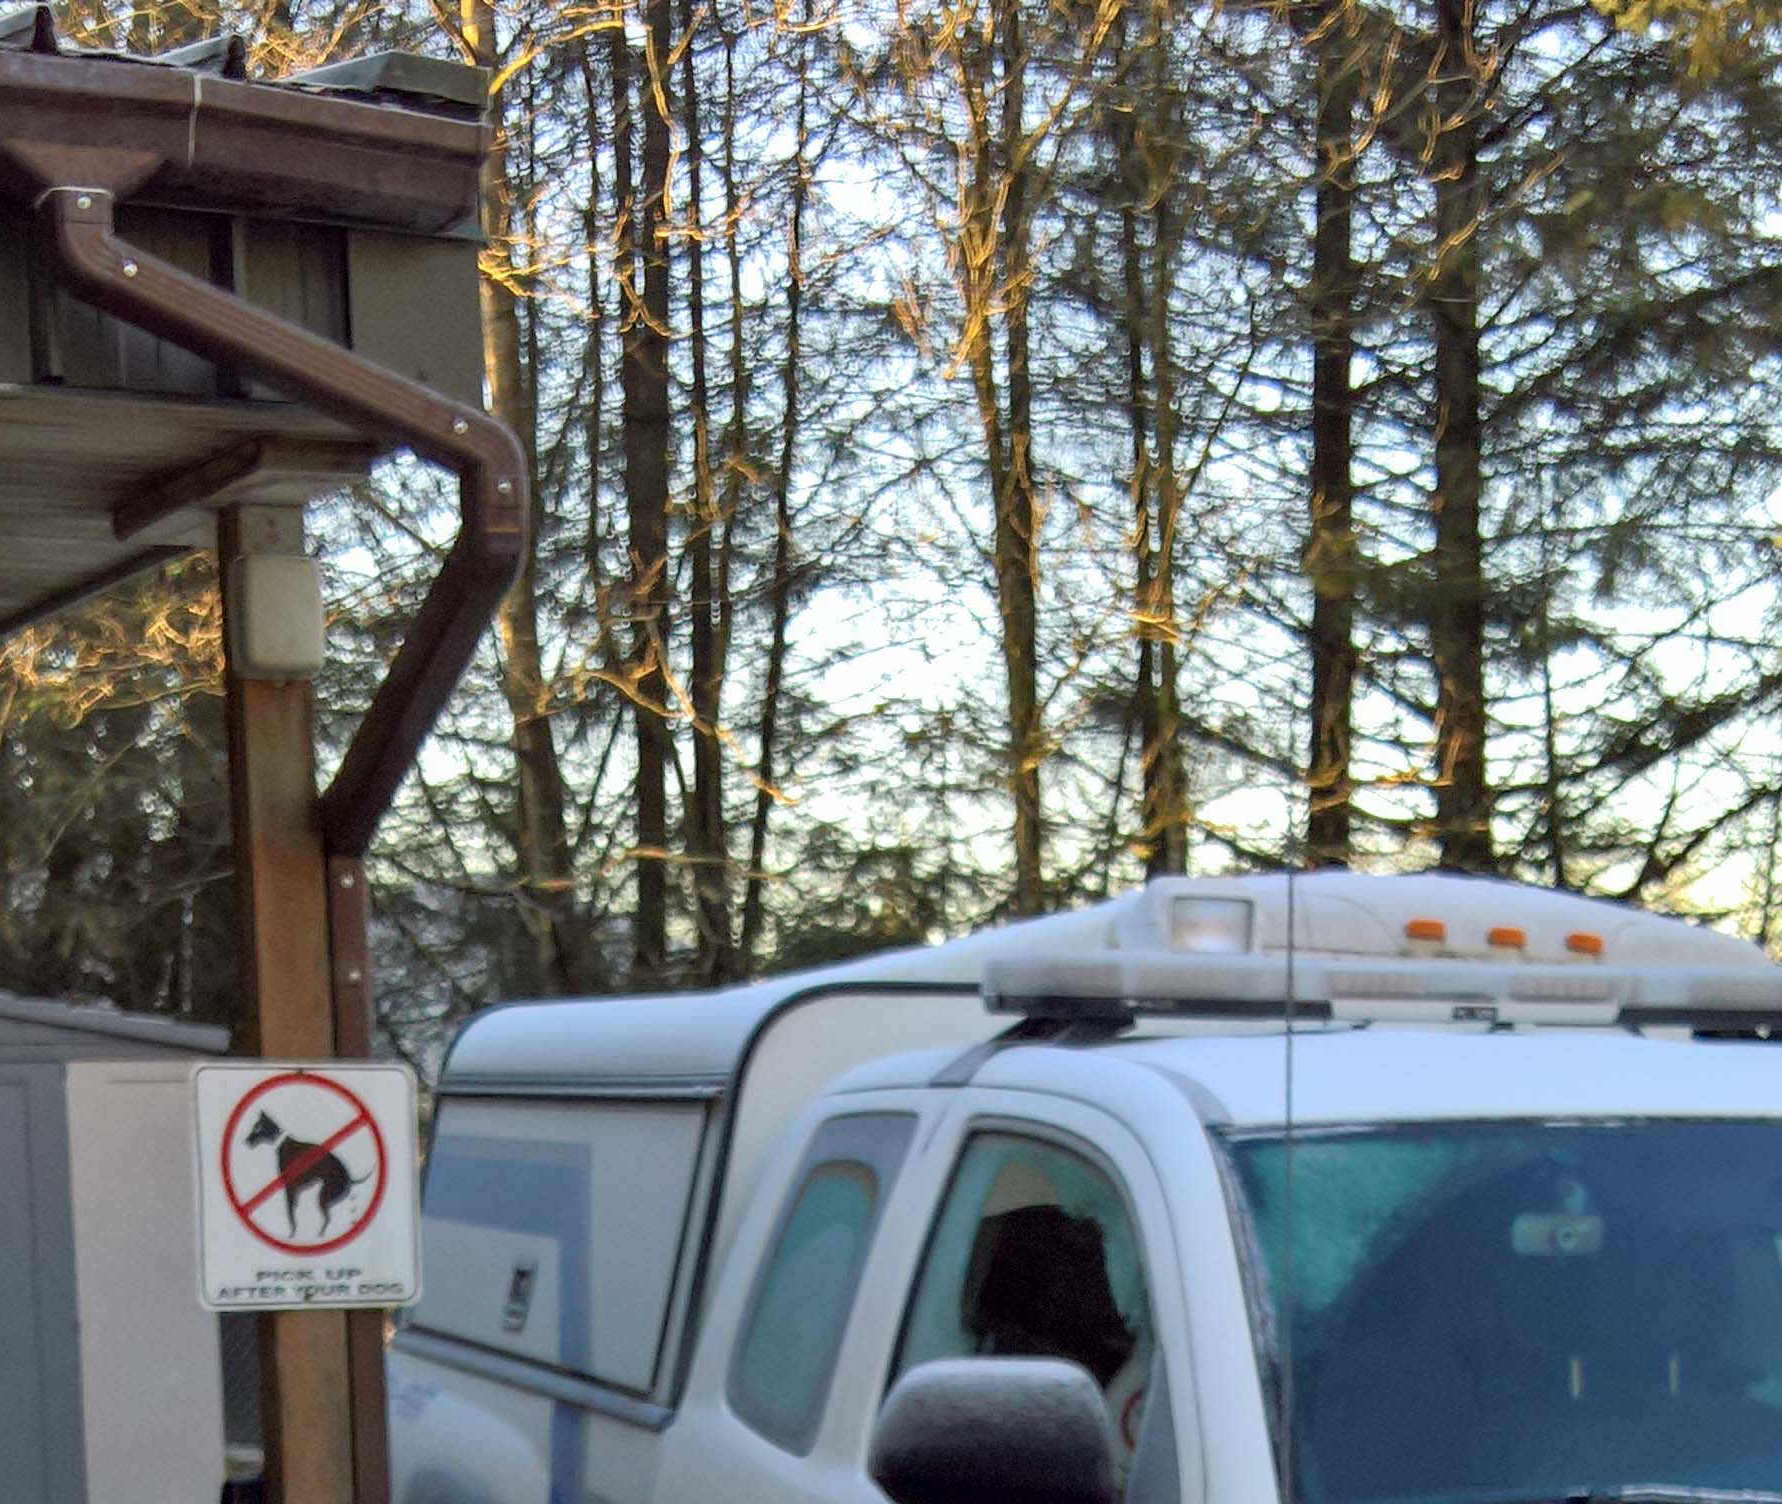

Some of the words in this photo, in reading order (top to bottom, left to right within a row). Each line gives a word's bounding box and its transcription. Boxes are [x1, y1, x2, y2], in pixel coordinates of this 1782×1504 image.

[255, 1269, 314, 1282] PICK
[325, 1268, 363, 1281] UP
[219, 1284, 286, 1299] AFTER
[293, 1283, 351, 1298] YOUR
[358, 1281, 404, 1295] DOG
